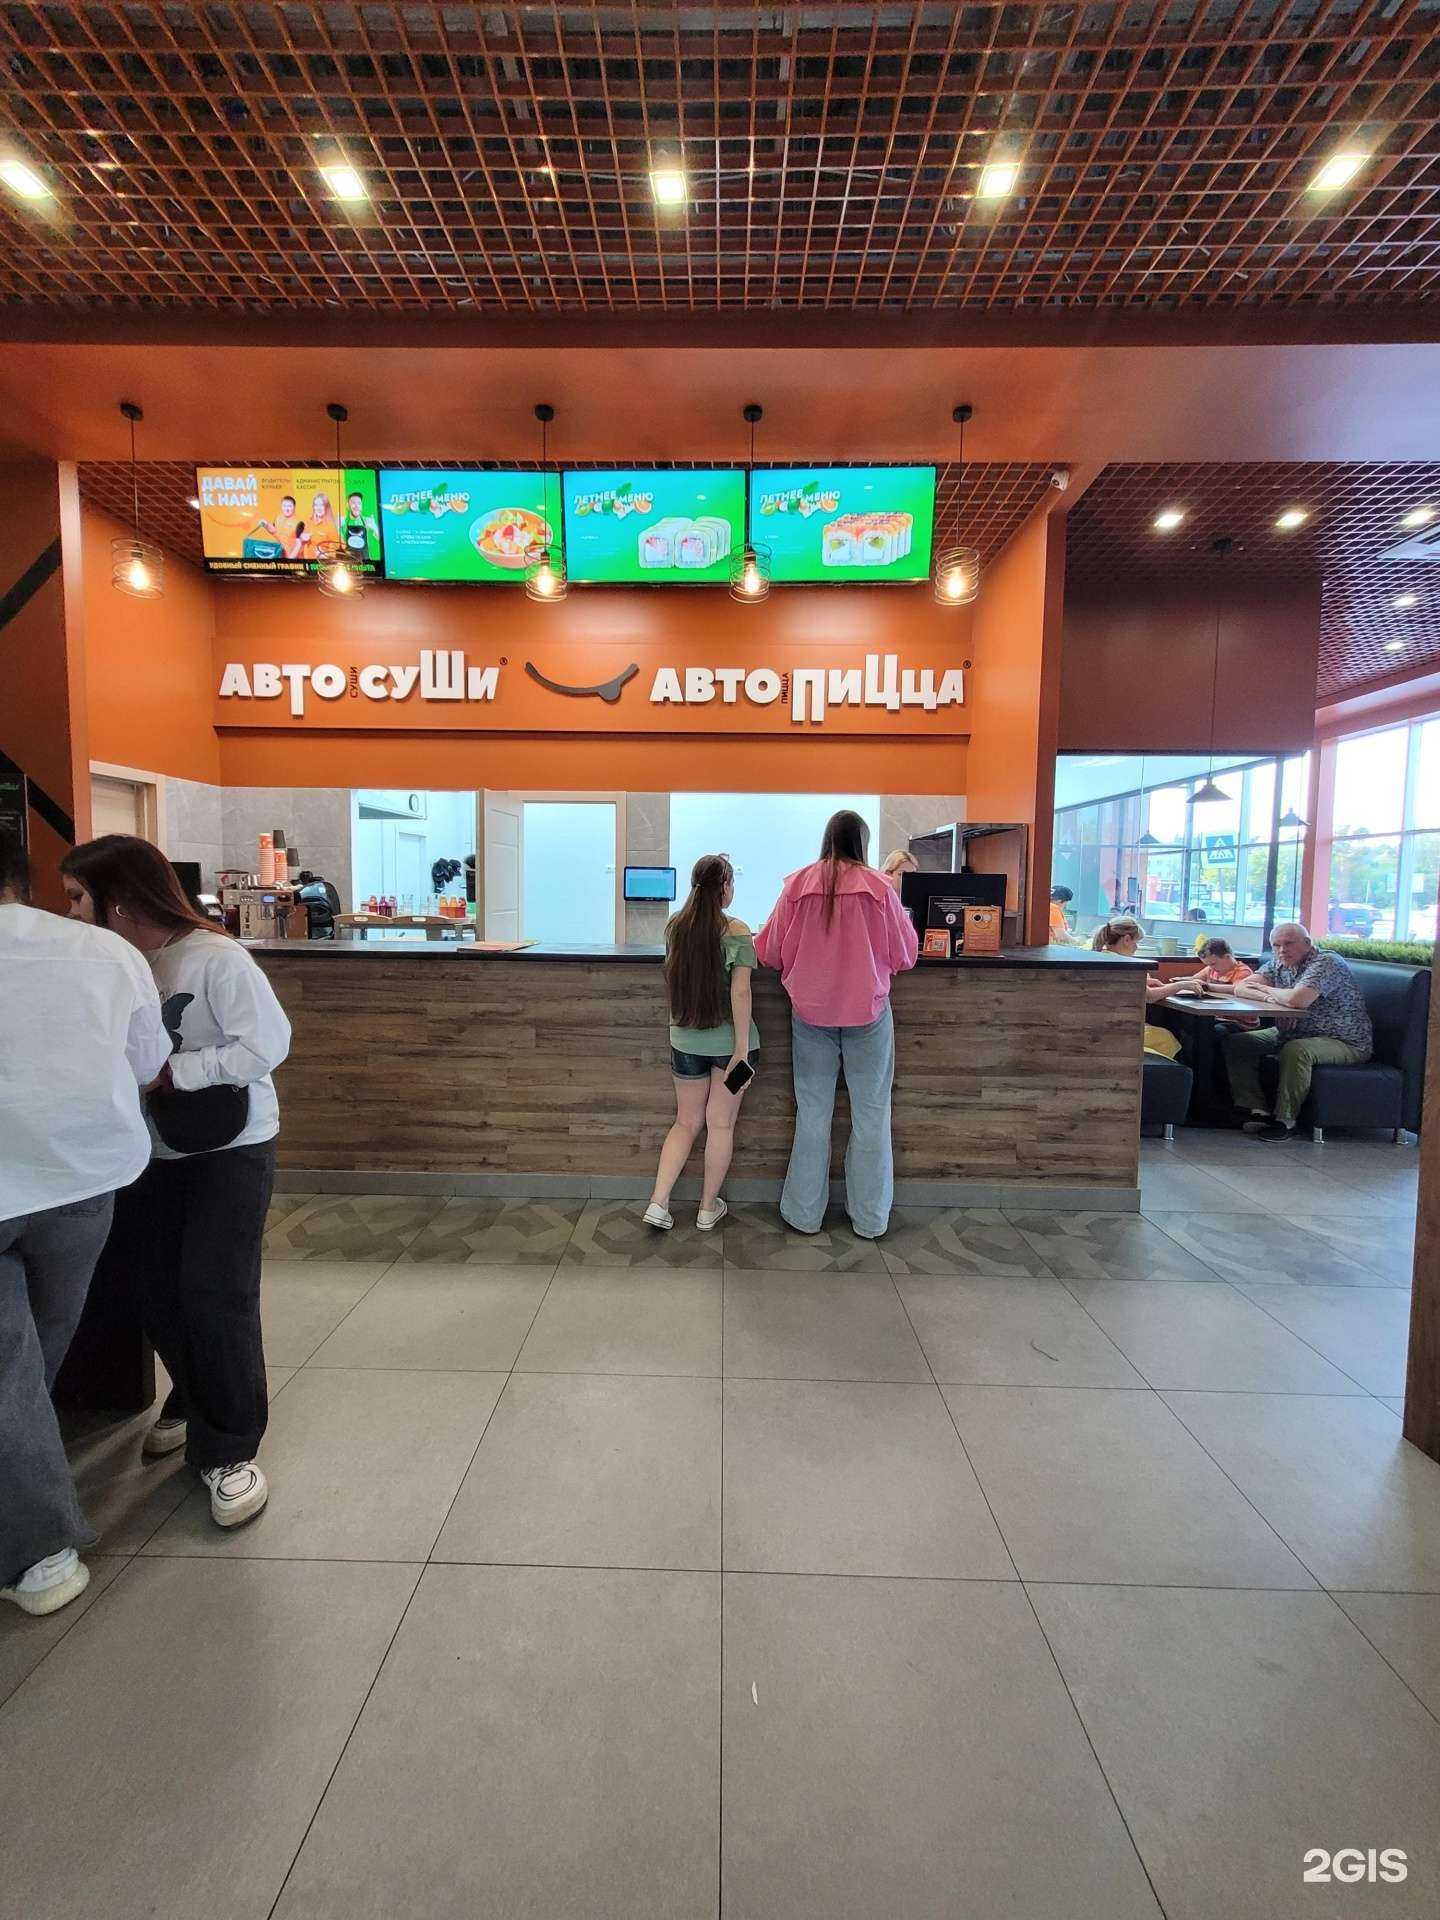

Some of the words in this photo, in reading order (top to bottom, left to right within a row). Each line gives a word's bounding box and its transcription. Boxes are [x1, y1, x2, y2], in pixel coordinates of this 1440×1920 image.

[202, 474, 257, 490] ДАВАЙ
[203, 493, 214, 506] К
[218, 492, 257, 506] НАМ!
[391, 489, 433, 504] ЛЕТНЕЕ
[574, 490, 617, 505] ЛЕТНЕЕ
[760, 488, 804, 505] ЛЕТНЕЕ
[218, 663, 347, 717] АВТО
[650, 668, 782, 704] АВТО
